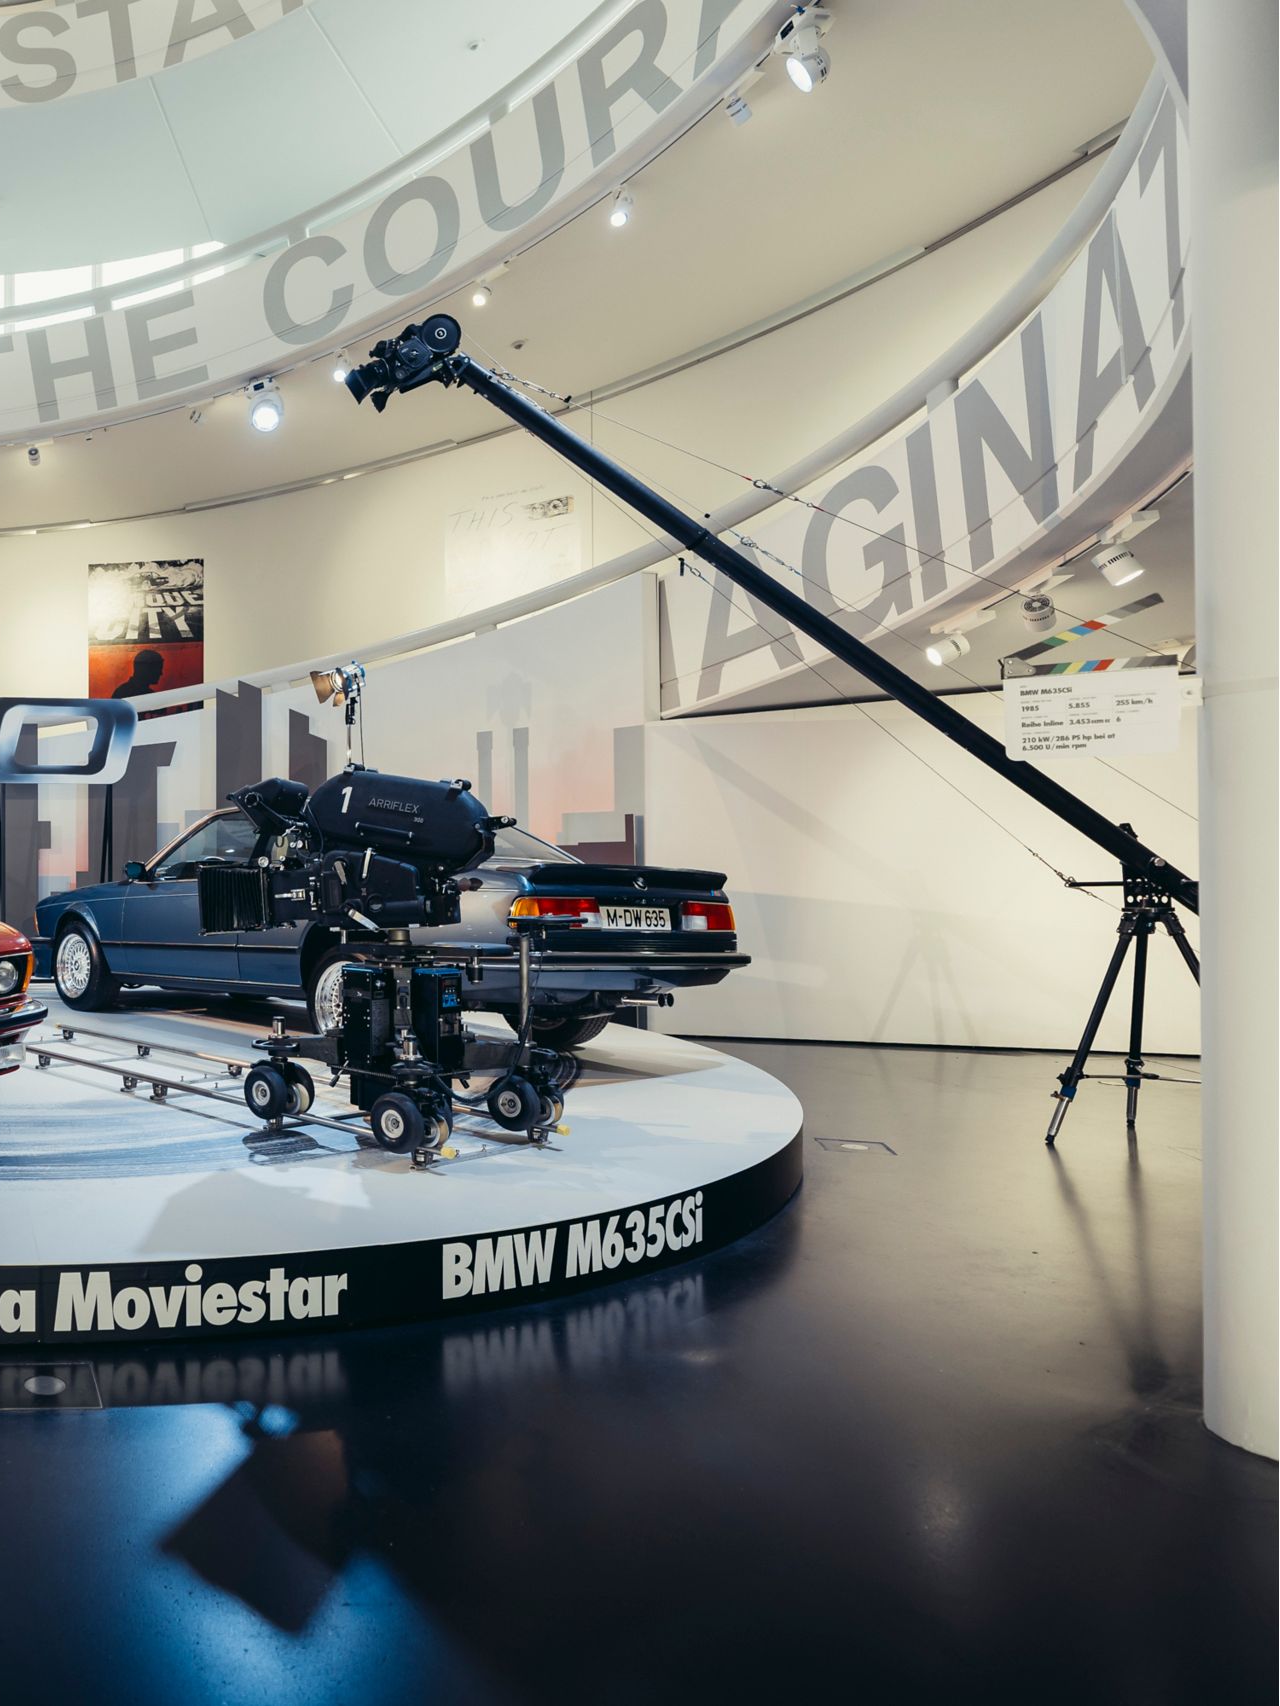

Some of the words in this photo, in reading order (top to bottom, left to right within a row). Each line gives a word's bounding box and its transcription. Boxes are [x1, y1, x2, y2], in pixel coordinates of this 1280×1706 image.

[659, 85, 1185, 708] AGINAT
[448, 501, 520, 534] THIS
[1021, 704, 1040, 712] 1985
[1068, 702, 1090, 710] 5.855
[1131, 697, 1153, 705] km/h
[1040, 687, 1072, 695] M635CSi
[1082, 734, 1093, 742] hp
[341, 786, 353, 814] 1
[368, 797, 420, 814] ARRIFLEX
[644, 909, 666, 928] 635
[442, 1227, 557, 1300] BMW
[565, 1191, 704, 1279] M635CSi
[53, 1264, 348, 1331] Moviestar
